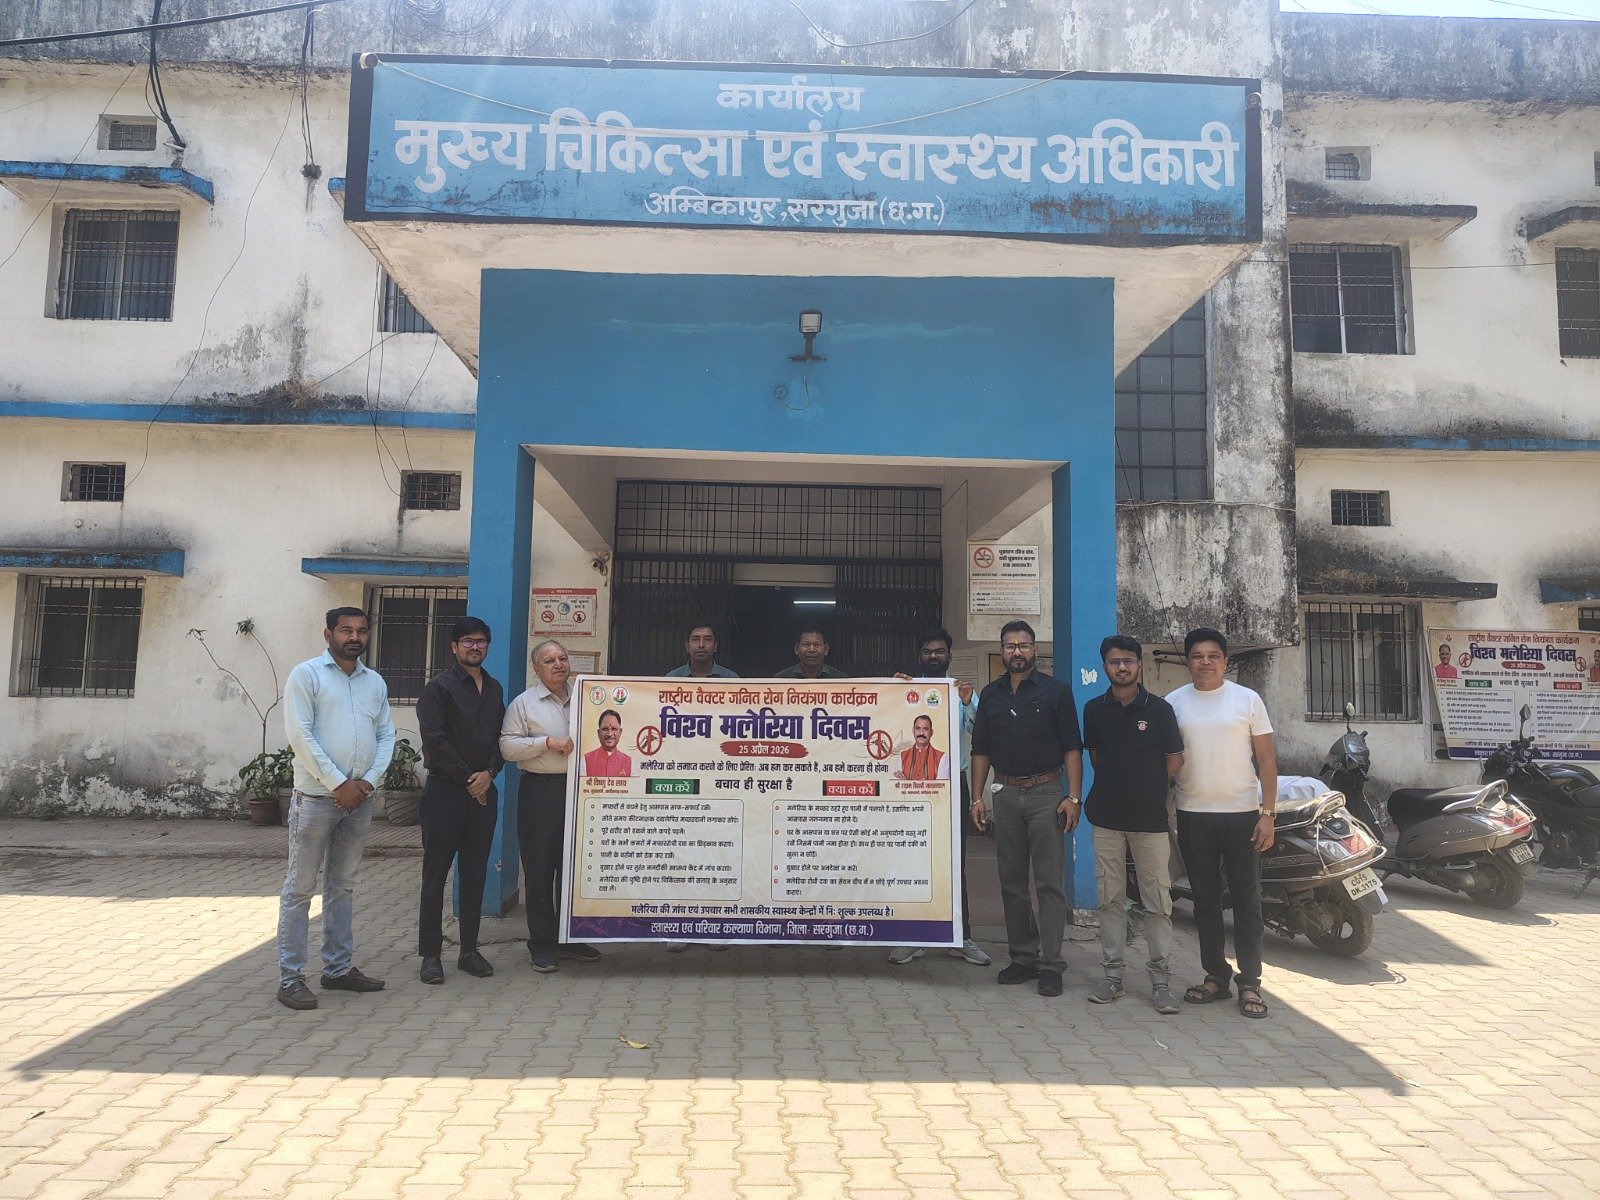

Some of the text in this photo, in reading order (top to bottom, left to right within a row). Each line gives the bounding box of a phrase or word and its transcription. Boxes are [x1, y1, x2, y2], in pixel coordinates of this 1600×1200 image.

[717, 74, 865, 118] कार्यालय
[395, 107, 1240, 194] मुख्य चिकित्सा एवं स्वास्थ्य अधिकारी
[1470, 643, 1576, 662] विश्व मलेरिया दिवस
[658, 686, 878, 708] राष्ट्रीय वैक्टर जनित रोग नियंत्रण कार्यक्रम
[659, 706, 871, 740] विश्व मलेरिया दिवस
[738, 744, 790, 755] 25 अप्रैल 2026
[640, 760, 664, 770] मलेरिया
[666, 760, 675, 770] को
[699, 760, 715, 770] करने
[716, 760, 724, 770] के
[726, 760, 738, 771] लिए
[770, 763, 780, 771] हम
[794, 761, 812, 771] सकते
[834, 761, 845, 772] हमें
[866, 761, 872, 772] ही
[874, 762, 888, 772] होगा
[655, 780, 690, 793] क्या करें
[714, 776, 792, 793] बचाव ही सुरक्षा है
[828, 784, 874, 796] क्या न करें
[631, 905, 658, 914] मलेरिया
[660, 905, 670, 914] की
[672, 906, 686, 914] जांच
[688, 906, 698, 914] एवं
[700, 907, 722, 916] उपचार
[724, 906, 738, 915] सभी
[740, 906, 770, 916] शासकीय
[772, 908, 797, 916] स्वास्थ्य
[799, 906, 816, 916] केन्द्रों
[838, 908, 855, 919] शुल्क
[858, 909, 882, 917] उपलब्ध
[651, 923, 680, 934] स्वास्थ्य
[682, 922, 693, 934] एवं
[695, 921, 721, 934] परिवार
[722, 923, 753, 934] कल्याण
[756, 922, 784, 936] विभाग,
[813, 926, 842, 938] सरगुजा
[844, 924, 874, 938] (छ.ग.)
